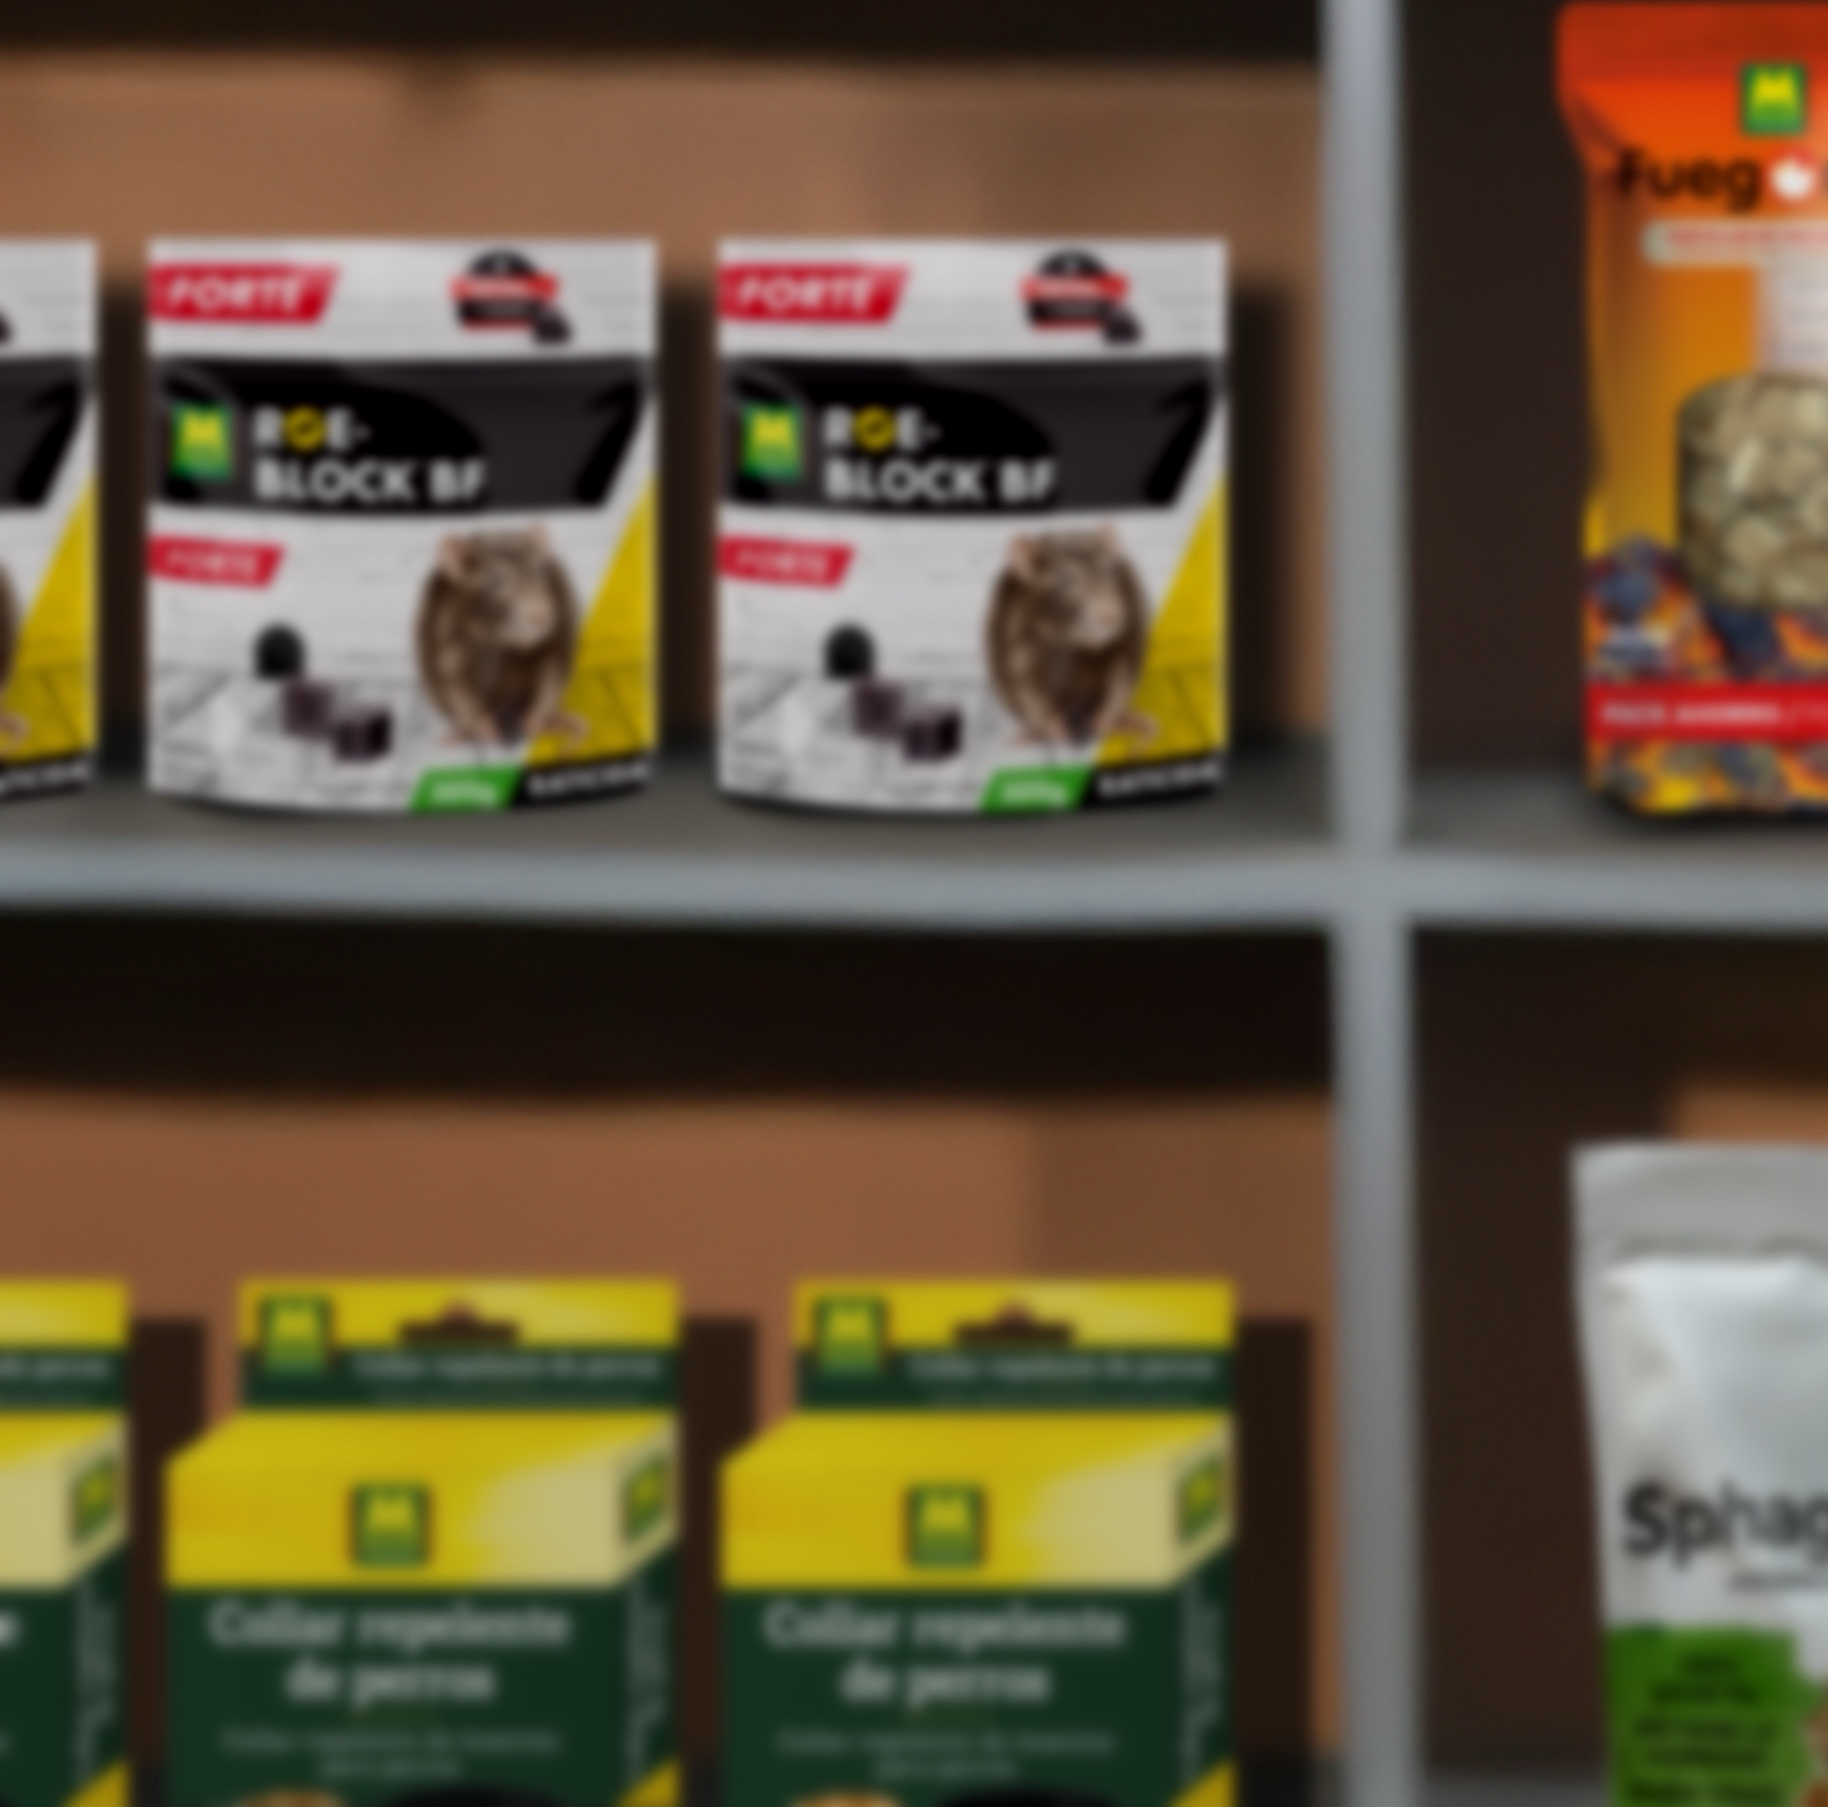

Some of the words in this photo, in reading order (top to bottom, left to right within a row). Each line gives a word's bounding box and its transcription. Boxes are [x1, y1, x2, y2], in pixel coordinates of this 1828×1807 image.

[164, 277, 309, 314] FORTE
[734, 277, 879, 314] FORTE
[253, 459, 415, 503] BLOCK
[431, 460, 488, 501] BF
[823, 459, 985, 503] BLOCK
[1001, 460, 1058, 501] BF
[167, 549, 260, 579] FORTE
[737, 549, 830, 579] FORTE
[211, 1602, 345, 1648] Collar
[766, 1603, 900, 1649] Collar
